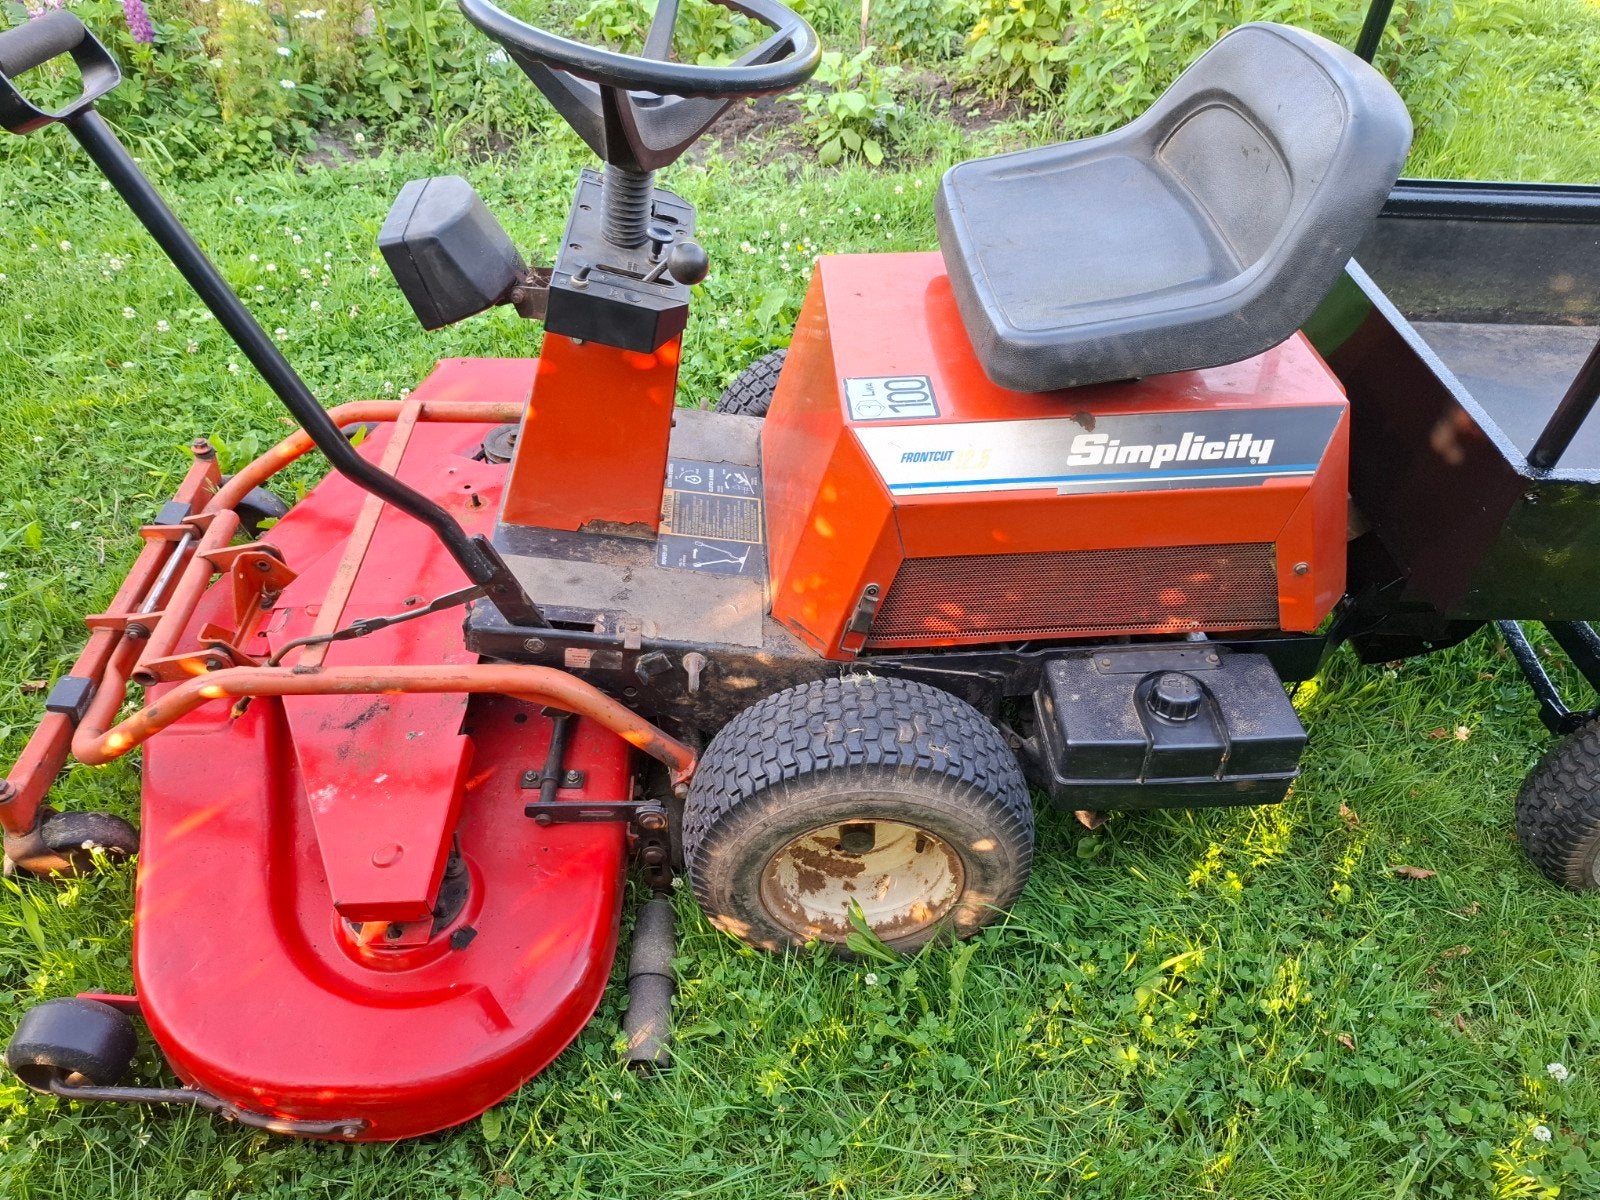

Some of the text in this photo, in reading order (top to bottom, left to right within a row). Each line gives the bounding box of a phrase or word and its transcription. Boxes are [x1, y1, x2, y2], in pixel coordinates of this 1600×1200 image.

[884, 379, 932, 413] 100
[900, 450, 955, 464] FRONTCUT
[1066, 432, 1275, 469] Simplicity
